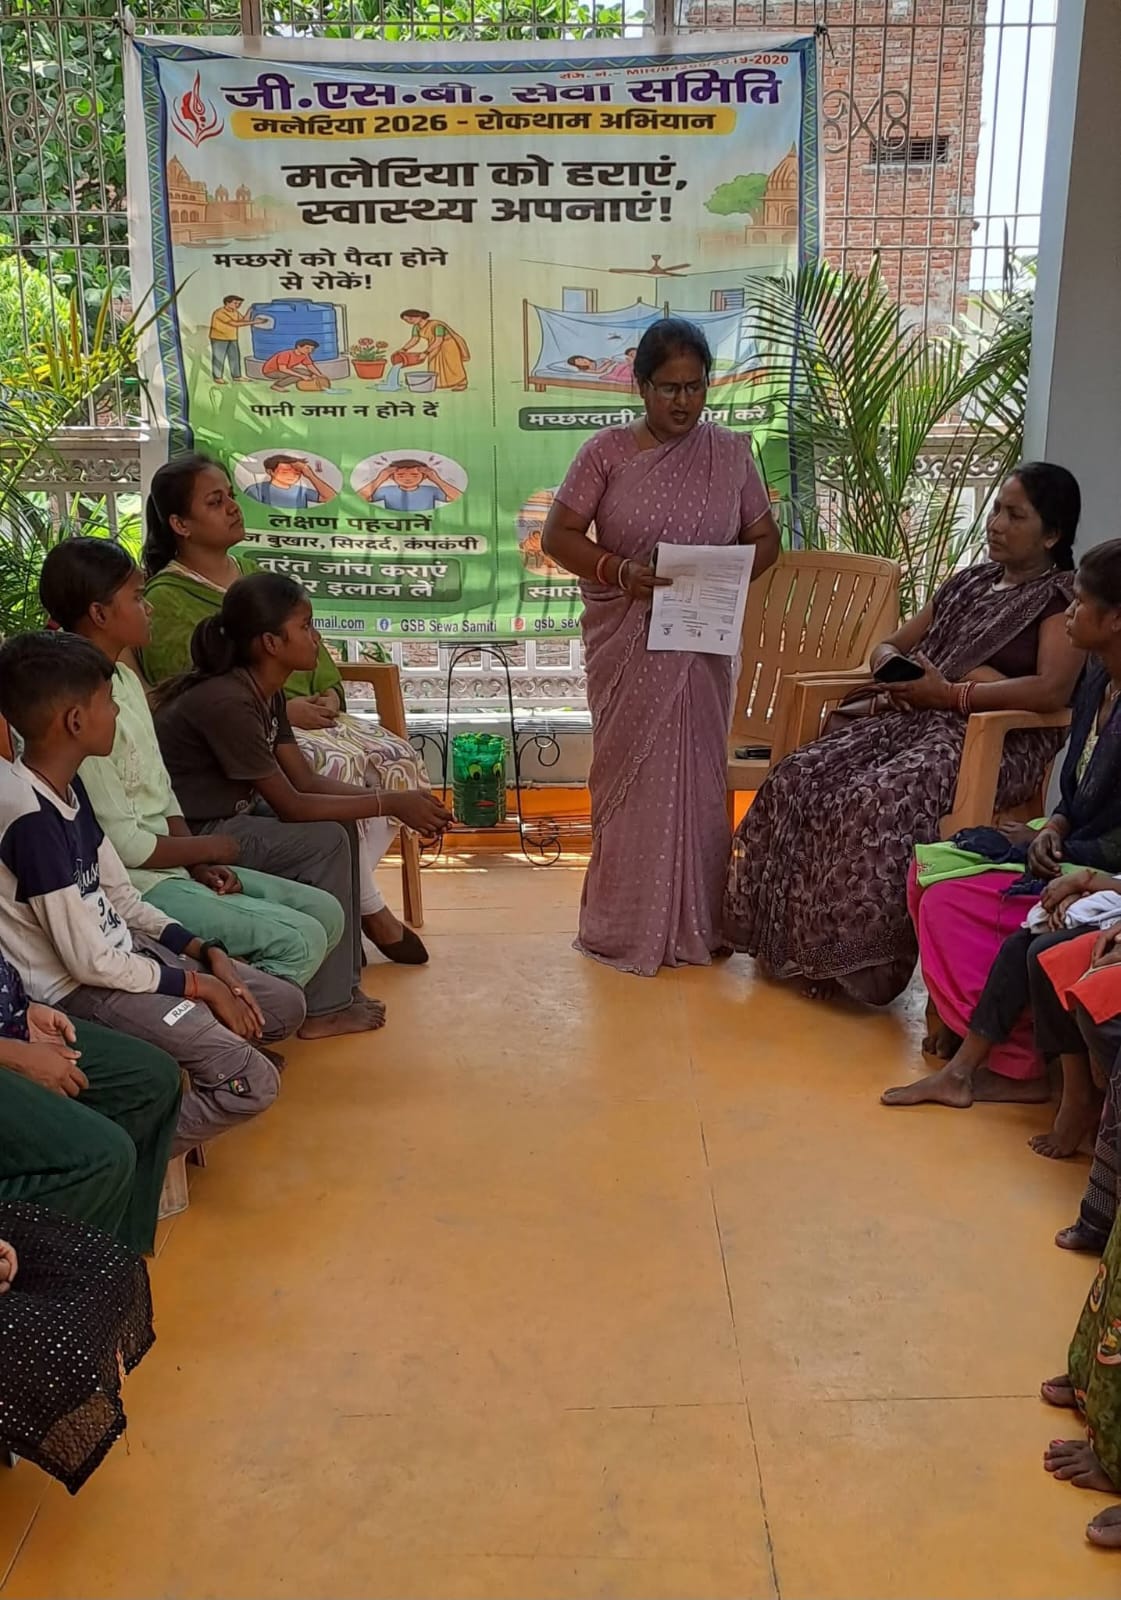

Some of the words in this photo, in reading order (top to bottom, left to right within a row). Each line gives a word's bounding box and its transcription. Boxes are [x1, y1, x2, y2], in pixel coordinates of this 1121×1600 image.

[220, 72, 494, 110] जी.एस.बी.
[510, 82, 615, 103] सेवा
[625, 67, 783, 105] समिति
[251, 112, 367, 135] मलेरिया
[373, 114, 448, 133] 2026
[475, 108, 593, 131] रोकथाम
[599, 108, 717, 130] अभियान
[280, 157, 479, 190] मलेरिया
[487, 154, 554, 188] को
[561, 155, 688, 191] हराएं,
[297, 197, 478, 225] स्वास्थ्य
[491, 190, 672, 223] अपनाएं!
[213, 248, 291, 268] मच्छरों
[298, 248, 337, 267] को
[344, 247, 393, 267] पैदा
[400, 247, 449, 267] होने
[279, 271, 303, 290] से
[311, 271, 372, 290] रोकें!
[250, 401, 294, 418] पानी
[301, 404, 346, 418] जमा
[353, 404, 370, 417] न
[376, 400, 416, 418] होने
[423, 401, 441, 418] दें
[527, 408, 637, 426] मच्छरदानी
[734, 405, 768, 421] करें
[268, 513, 338, 530] लक्षण
[346, 513, 433, 533] पहचानें
[244, 532, 262, 543] ज
[266, 534, 326, 549] बुखार,
[329, 536, 398, 552] सिरदर्द,
[403, 535, 481, 550] कंपकंपी
[319, 559, 373, 577] जांच
[380, 560, 449, 578] कराएं
[326, 580, 403, 597] इलाज
[408, 579, 435, 597] लें
[312, 615, 365, 630] mail.com
[400, 618, 426, 632] GSB
[429, 618, 458, 632] Sewa
[462, 618, 497, 632] Samiti
